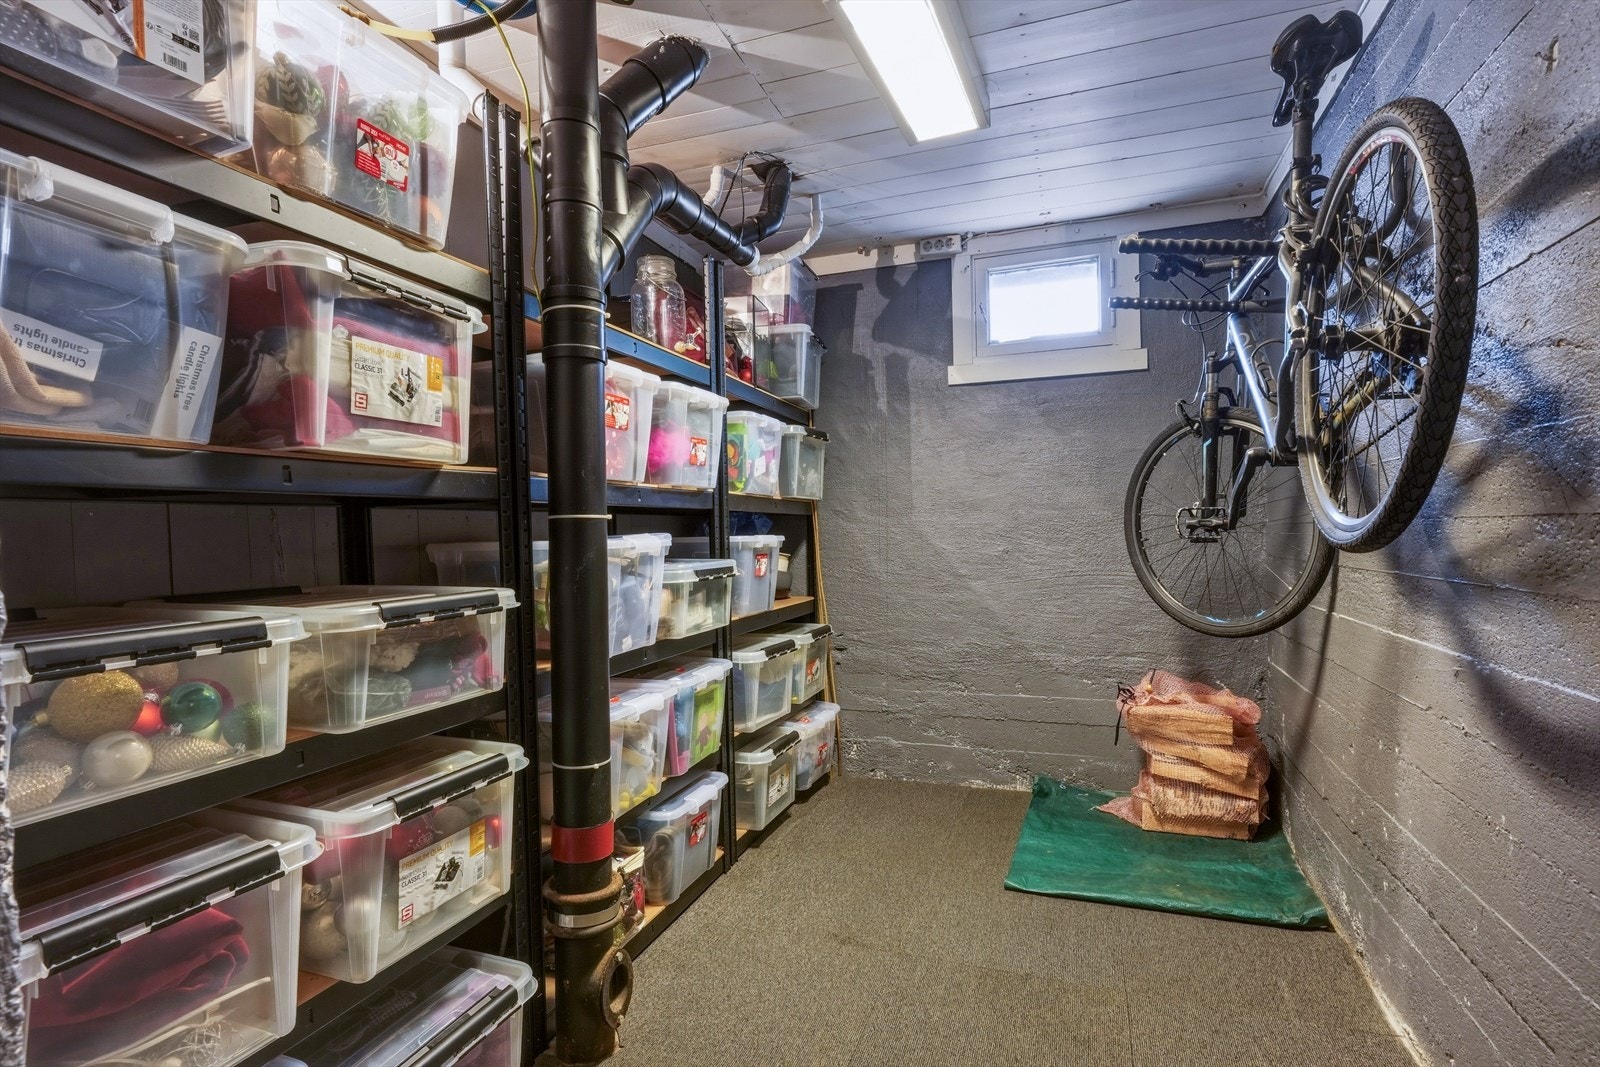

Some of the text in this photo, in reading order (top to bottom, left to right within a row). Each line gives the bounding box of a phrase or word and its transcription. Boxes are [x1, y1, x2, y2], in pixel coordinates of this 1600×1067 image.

[14, 324, 89, 354] candle lights
[356, 342, 410, 361] PREMIUM QUALITY
[26, 341, 86, 368] Christmas
[355, 362, 375, 373] CLASSIC
[174, 341, 197, 398] candle lights
[182, 344, 210, 410] Christmas tree
[402, 840, 454, 870] PREMIUM QUALITY
[401, 874, 422, 888] CLASSIC
